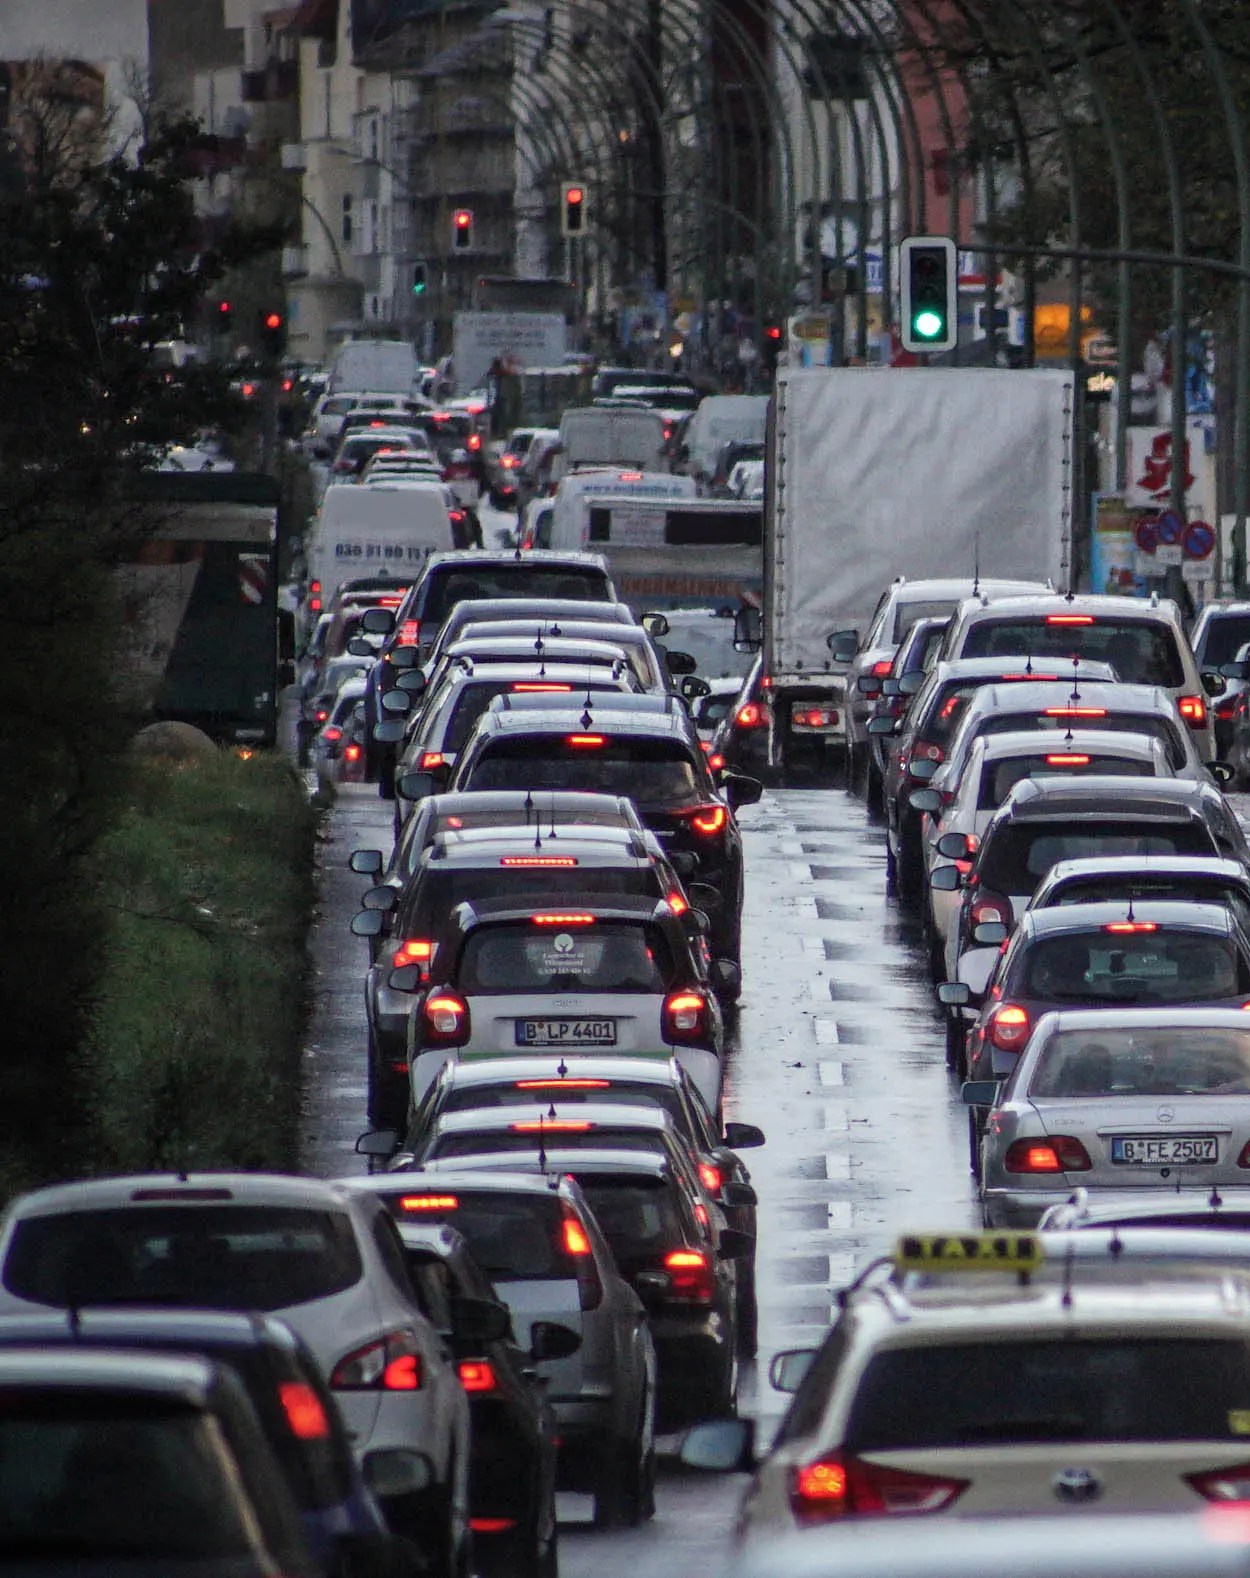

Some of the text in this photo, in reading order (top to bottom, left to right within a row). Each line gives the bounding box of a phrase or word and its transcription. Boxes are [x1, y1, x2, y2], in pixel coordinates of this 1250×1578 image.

[527, 1020, 614, 1039] B LP 4401
[1124, 1140, 1213, 1158] B FE 2507
